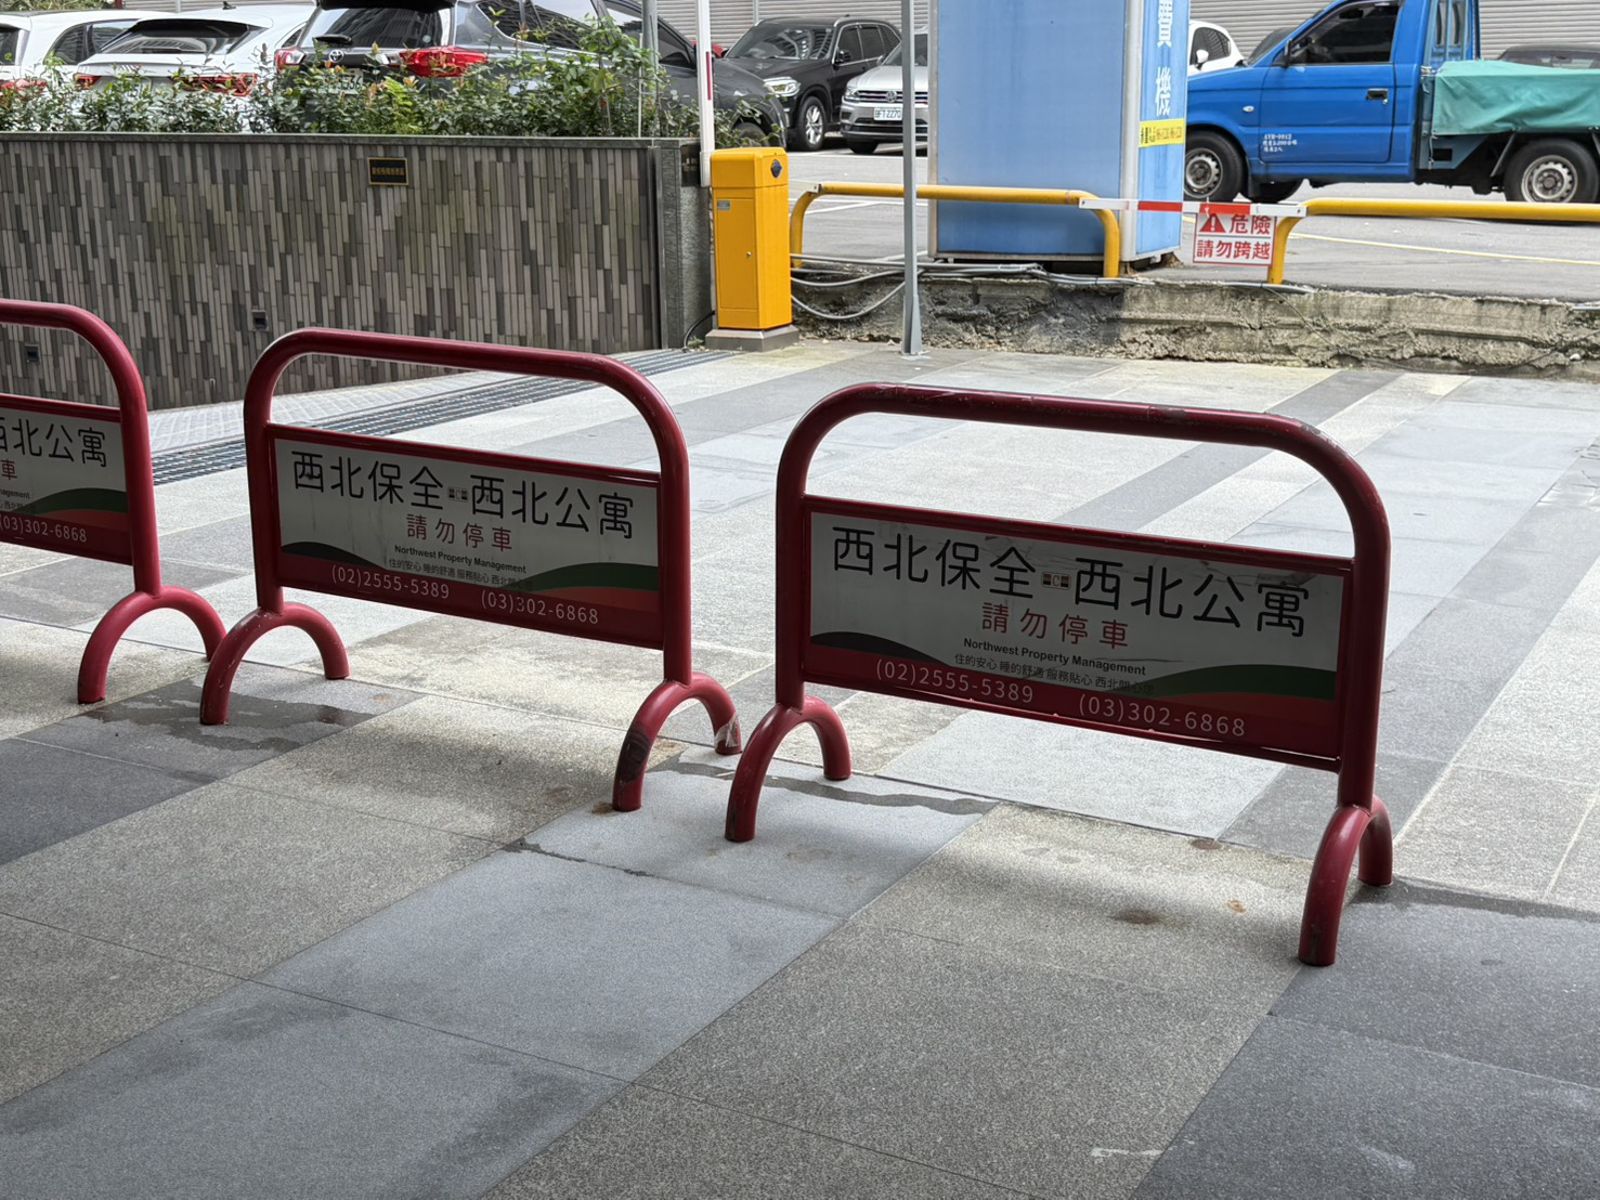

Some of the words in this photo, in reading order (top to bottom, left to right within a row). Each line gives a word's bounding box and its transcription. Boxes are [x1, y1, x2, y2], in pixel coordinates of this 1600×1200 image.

[1228, 214, 1272, 235] 危險
[1196, 239, 1272, 261] 請勿跨越
[291, 450, 444, 511] 西北保全
[469, 473, 634, 540] 西北公寓
[406, 513, 513, 553] 請勿停車
[394, 544, 437, 560] Northwest
[438, 551, 472, 567] Property
[473, 556, 528, 574] Management
[331, 563, 450, 600] (02)2555-5389
[480, 588, 599, 625] (03)302-6868
[832, 526, 1037, 599] 西北保全
[1074, 556, 1311, 638] 西北公寓
[981, 601, 1130, 650] 請勿停車
[963, 637, 1020, 656] Northwest
[1021, 646, 1070, 666] Property
[1072, 655, 1147, 676] Management
[876, 659, 1035, 704] (02)2555-5389
[1078, 692, 1246, 738] (03)302-6868
